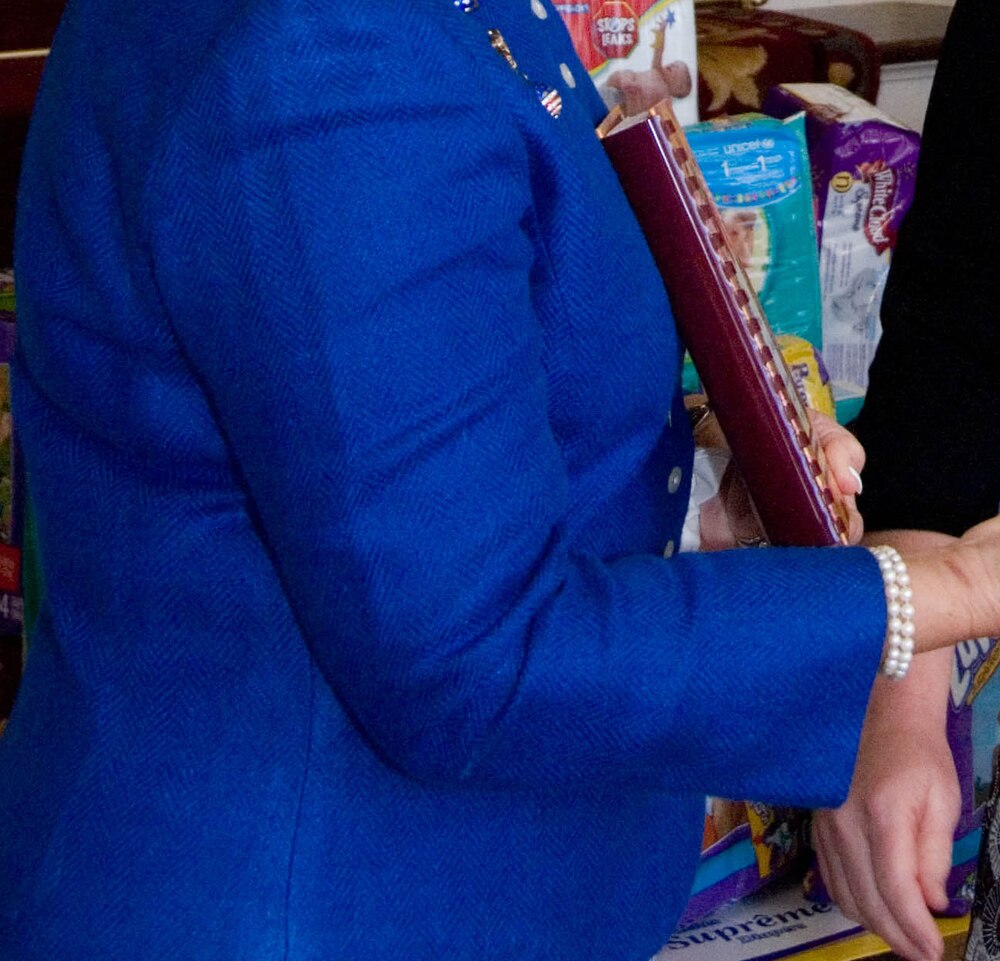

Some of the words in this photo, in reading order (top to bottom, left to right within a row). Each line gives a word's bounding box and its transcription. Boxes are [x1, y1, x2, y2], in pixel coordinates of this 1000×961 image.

[597, 17, 636, 32] STOPS
[601, 32, 634, 47] LEAKS
[871, 168, 893, 206] White
[667, 903, 833, 950] Suprême
